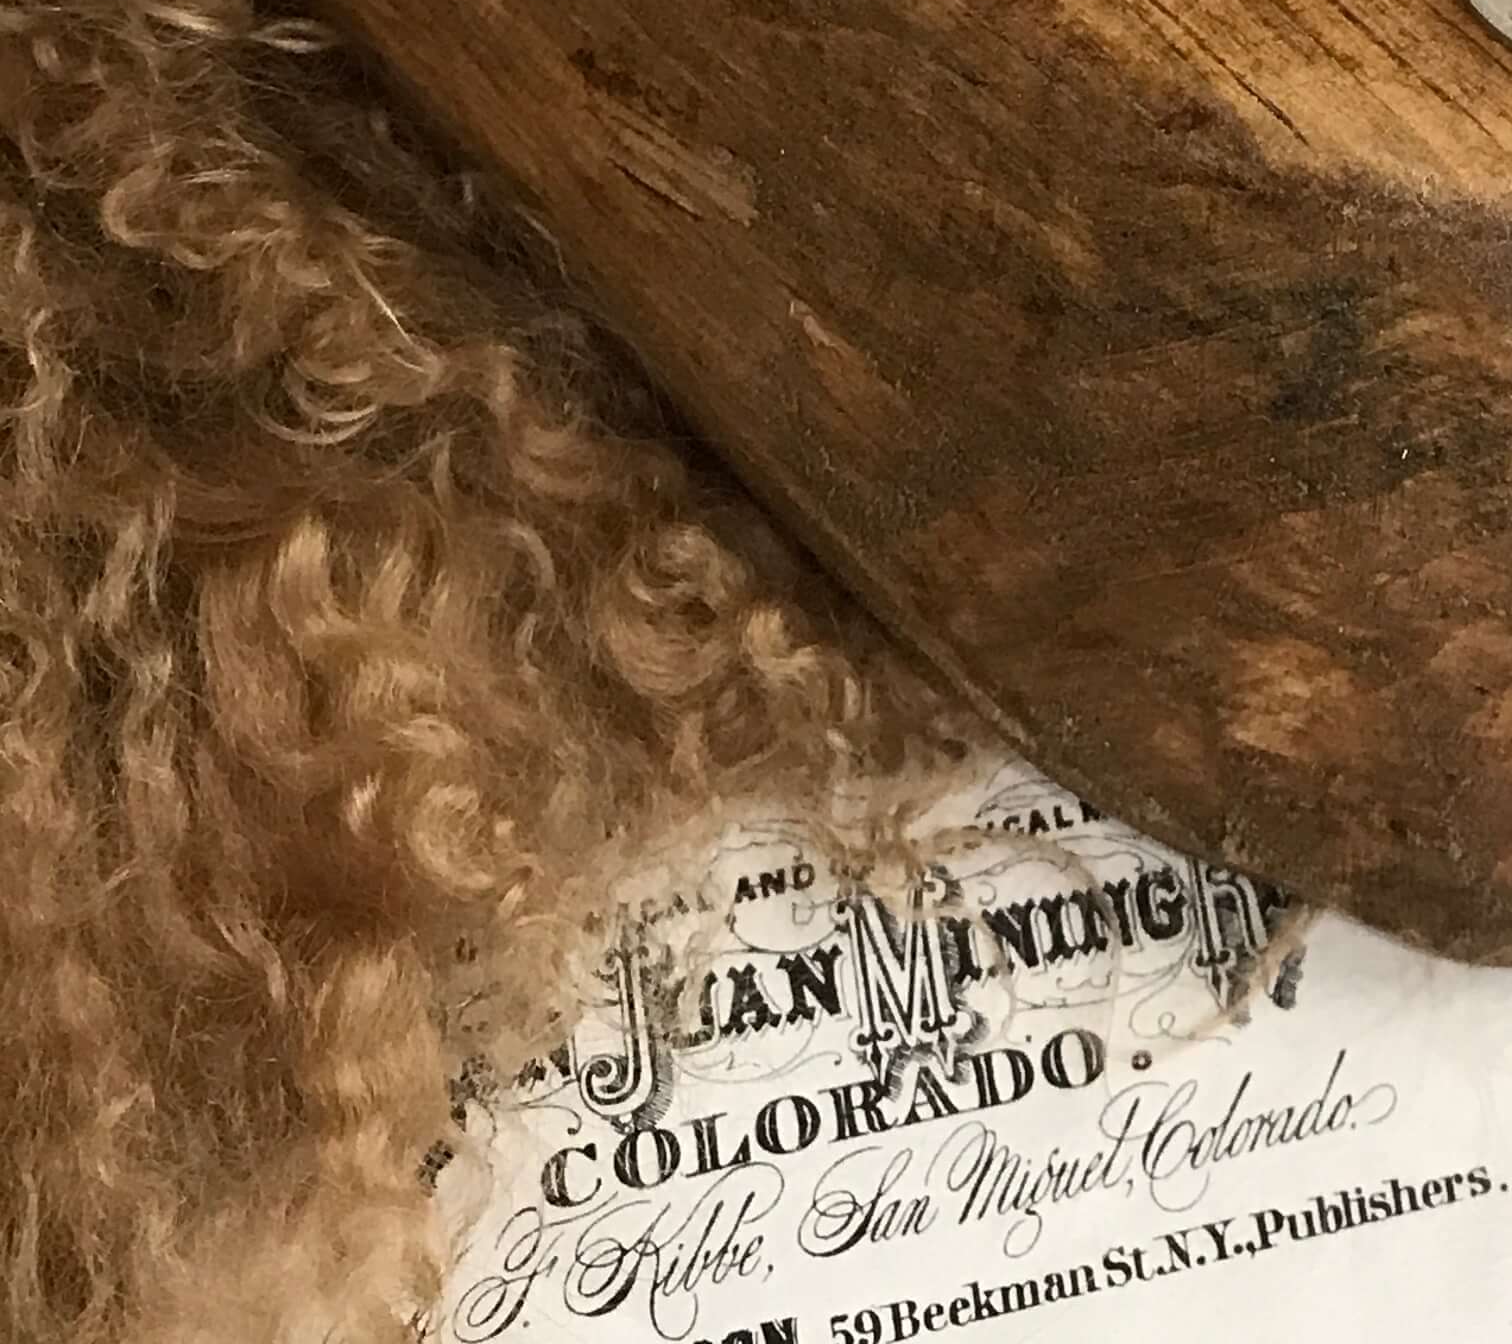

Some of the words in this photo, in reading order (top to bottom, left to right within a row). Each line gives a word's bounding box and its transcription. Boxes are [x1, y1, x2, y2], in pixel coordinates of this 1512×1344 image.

[734, 861, 816, 904] AND
[832, 867, 1188, 1062] MINING
[797, 1146, 940, 1257] San
[1142, 1048, 1398, 1213] Colorado.
[882, 1265, 1100, 1344] Beekman
